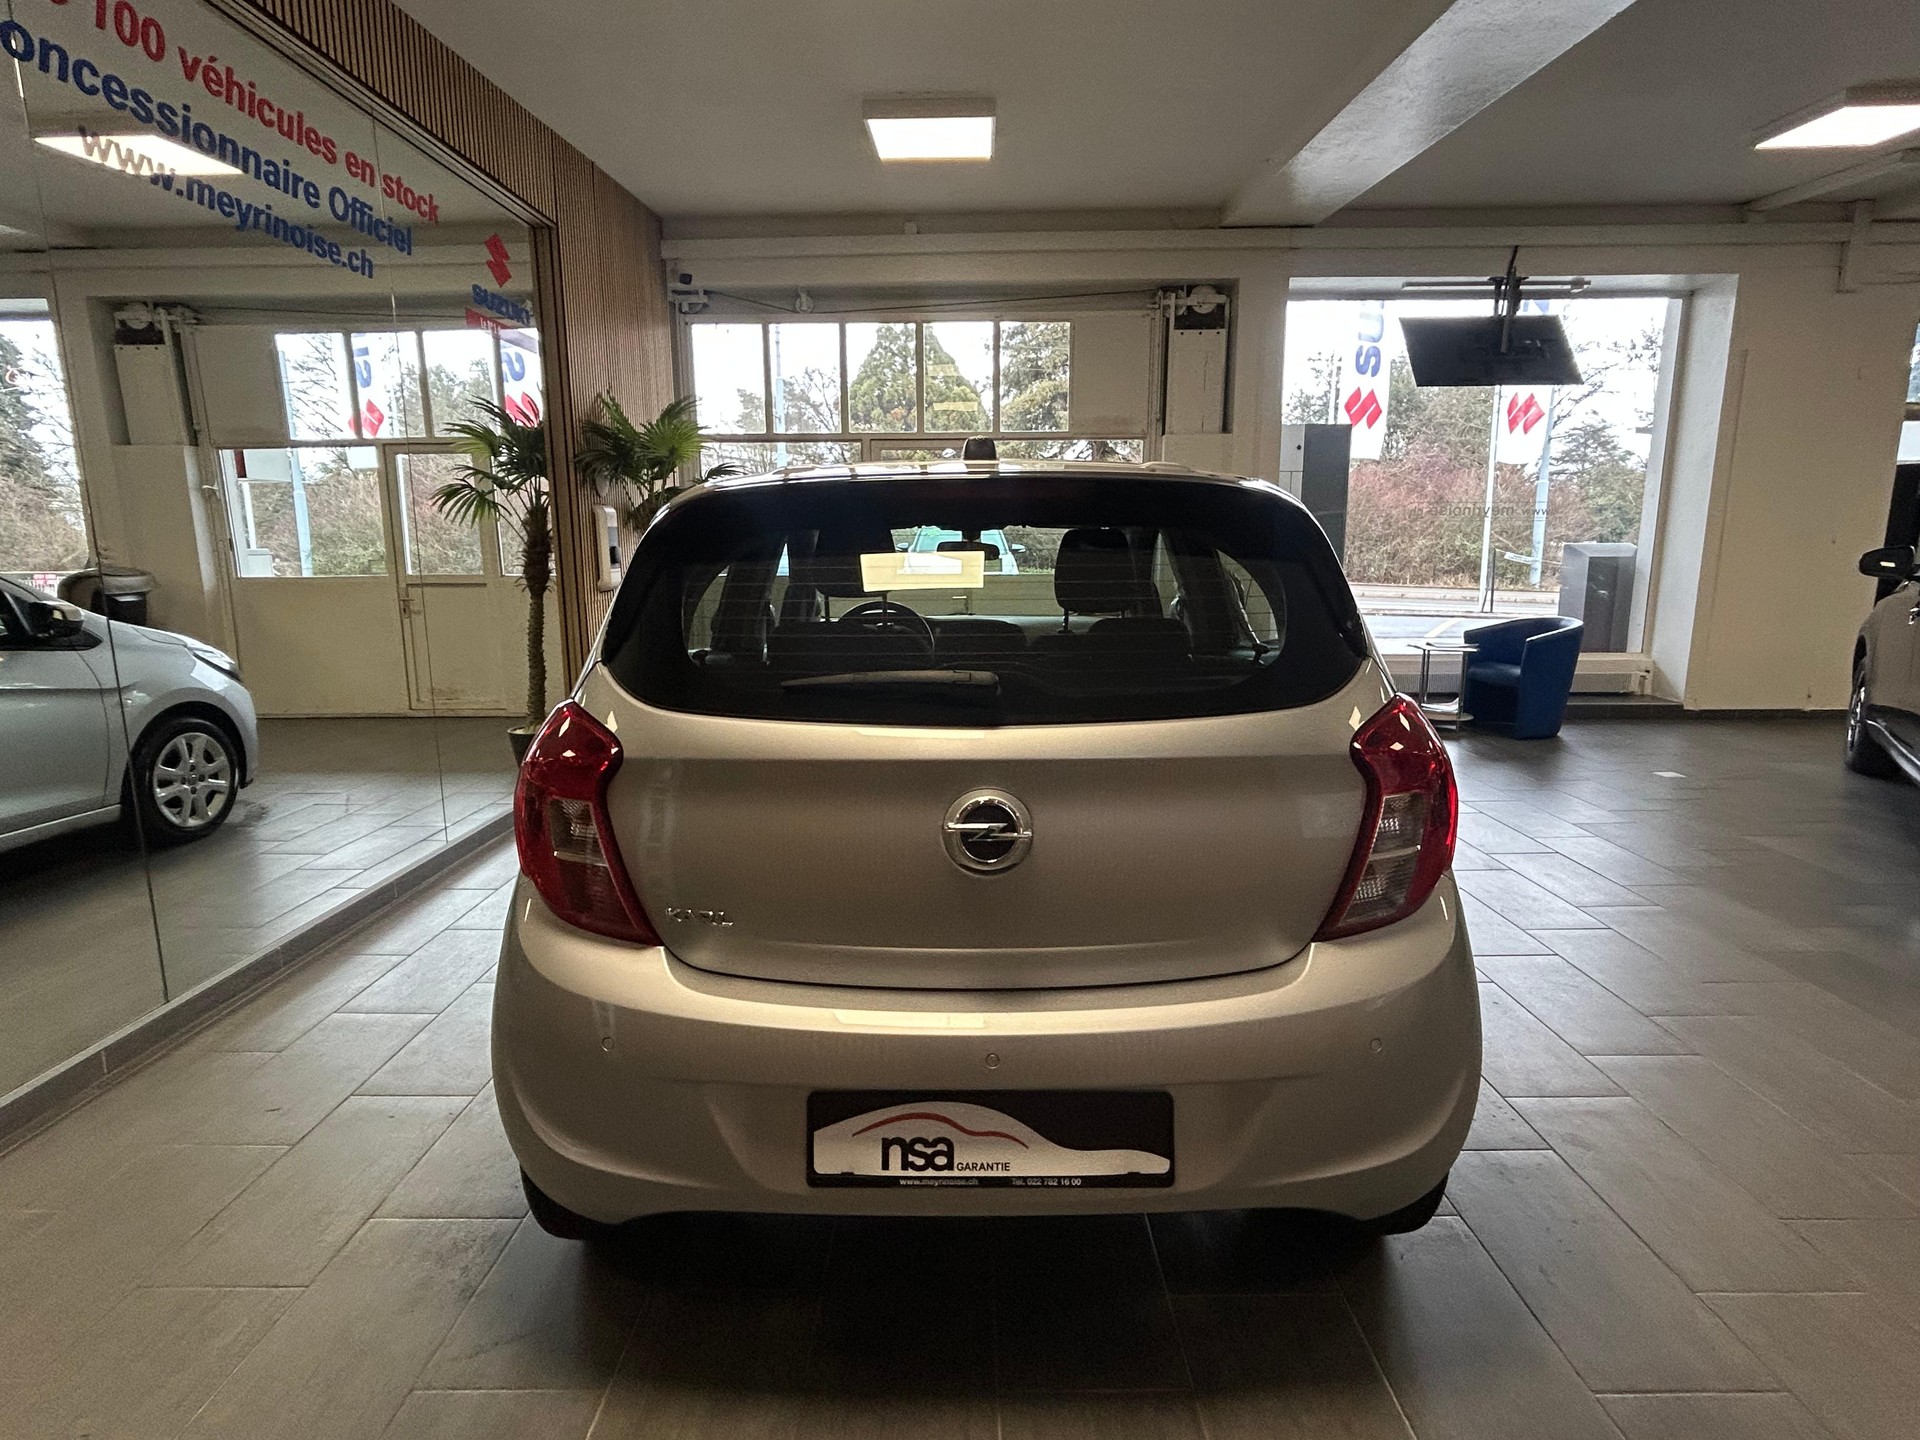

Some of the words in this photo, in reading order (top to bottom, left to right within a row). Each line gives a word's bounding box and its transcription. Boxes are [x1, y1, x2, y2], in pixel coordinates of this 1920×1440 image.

[95, 0, 166, 62] 100
[178, 46, 338, 165] véhicules
[345, 151, 376, 188] en
[382, 174, 440, 224] stock
[78, 124, 374, 279] www.meyrinoise.ch
[328, 187, 412, 256] Officiel
[1355, 300, 1384, 378] SU
[881, 1136, 955, 1172] nsa
[956, 1162, 1011, 1172] GARANTIE
[1071, 1177, 1082, 1186] 00
